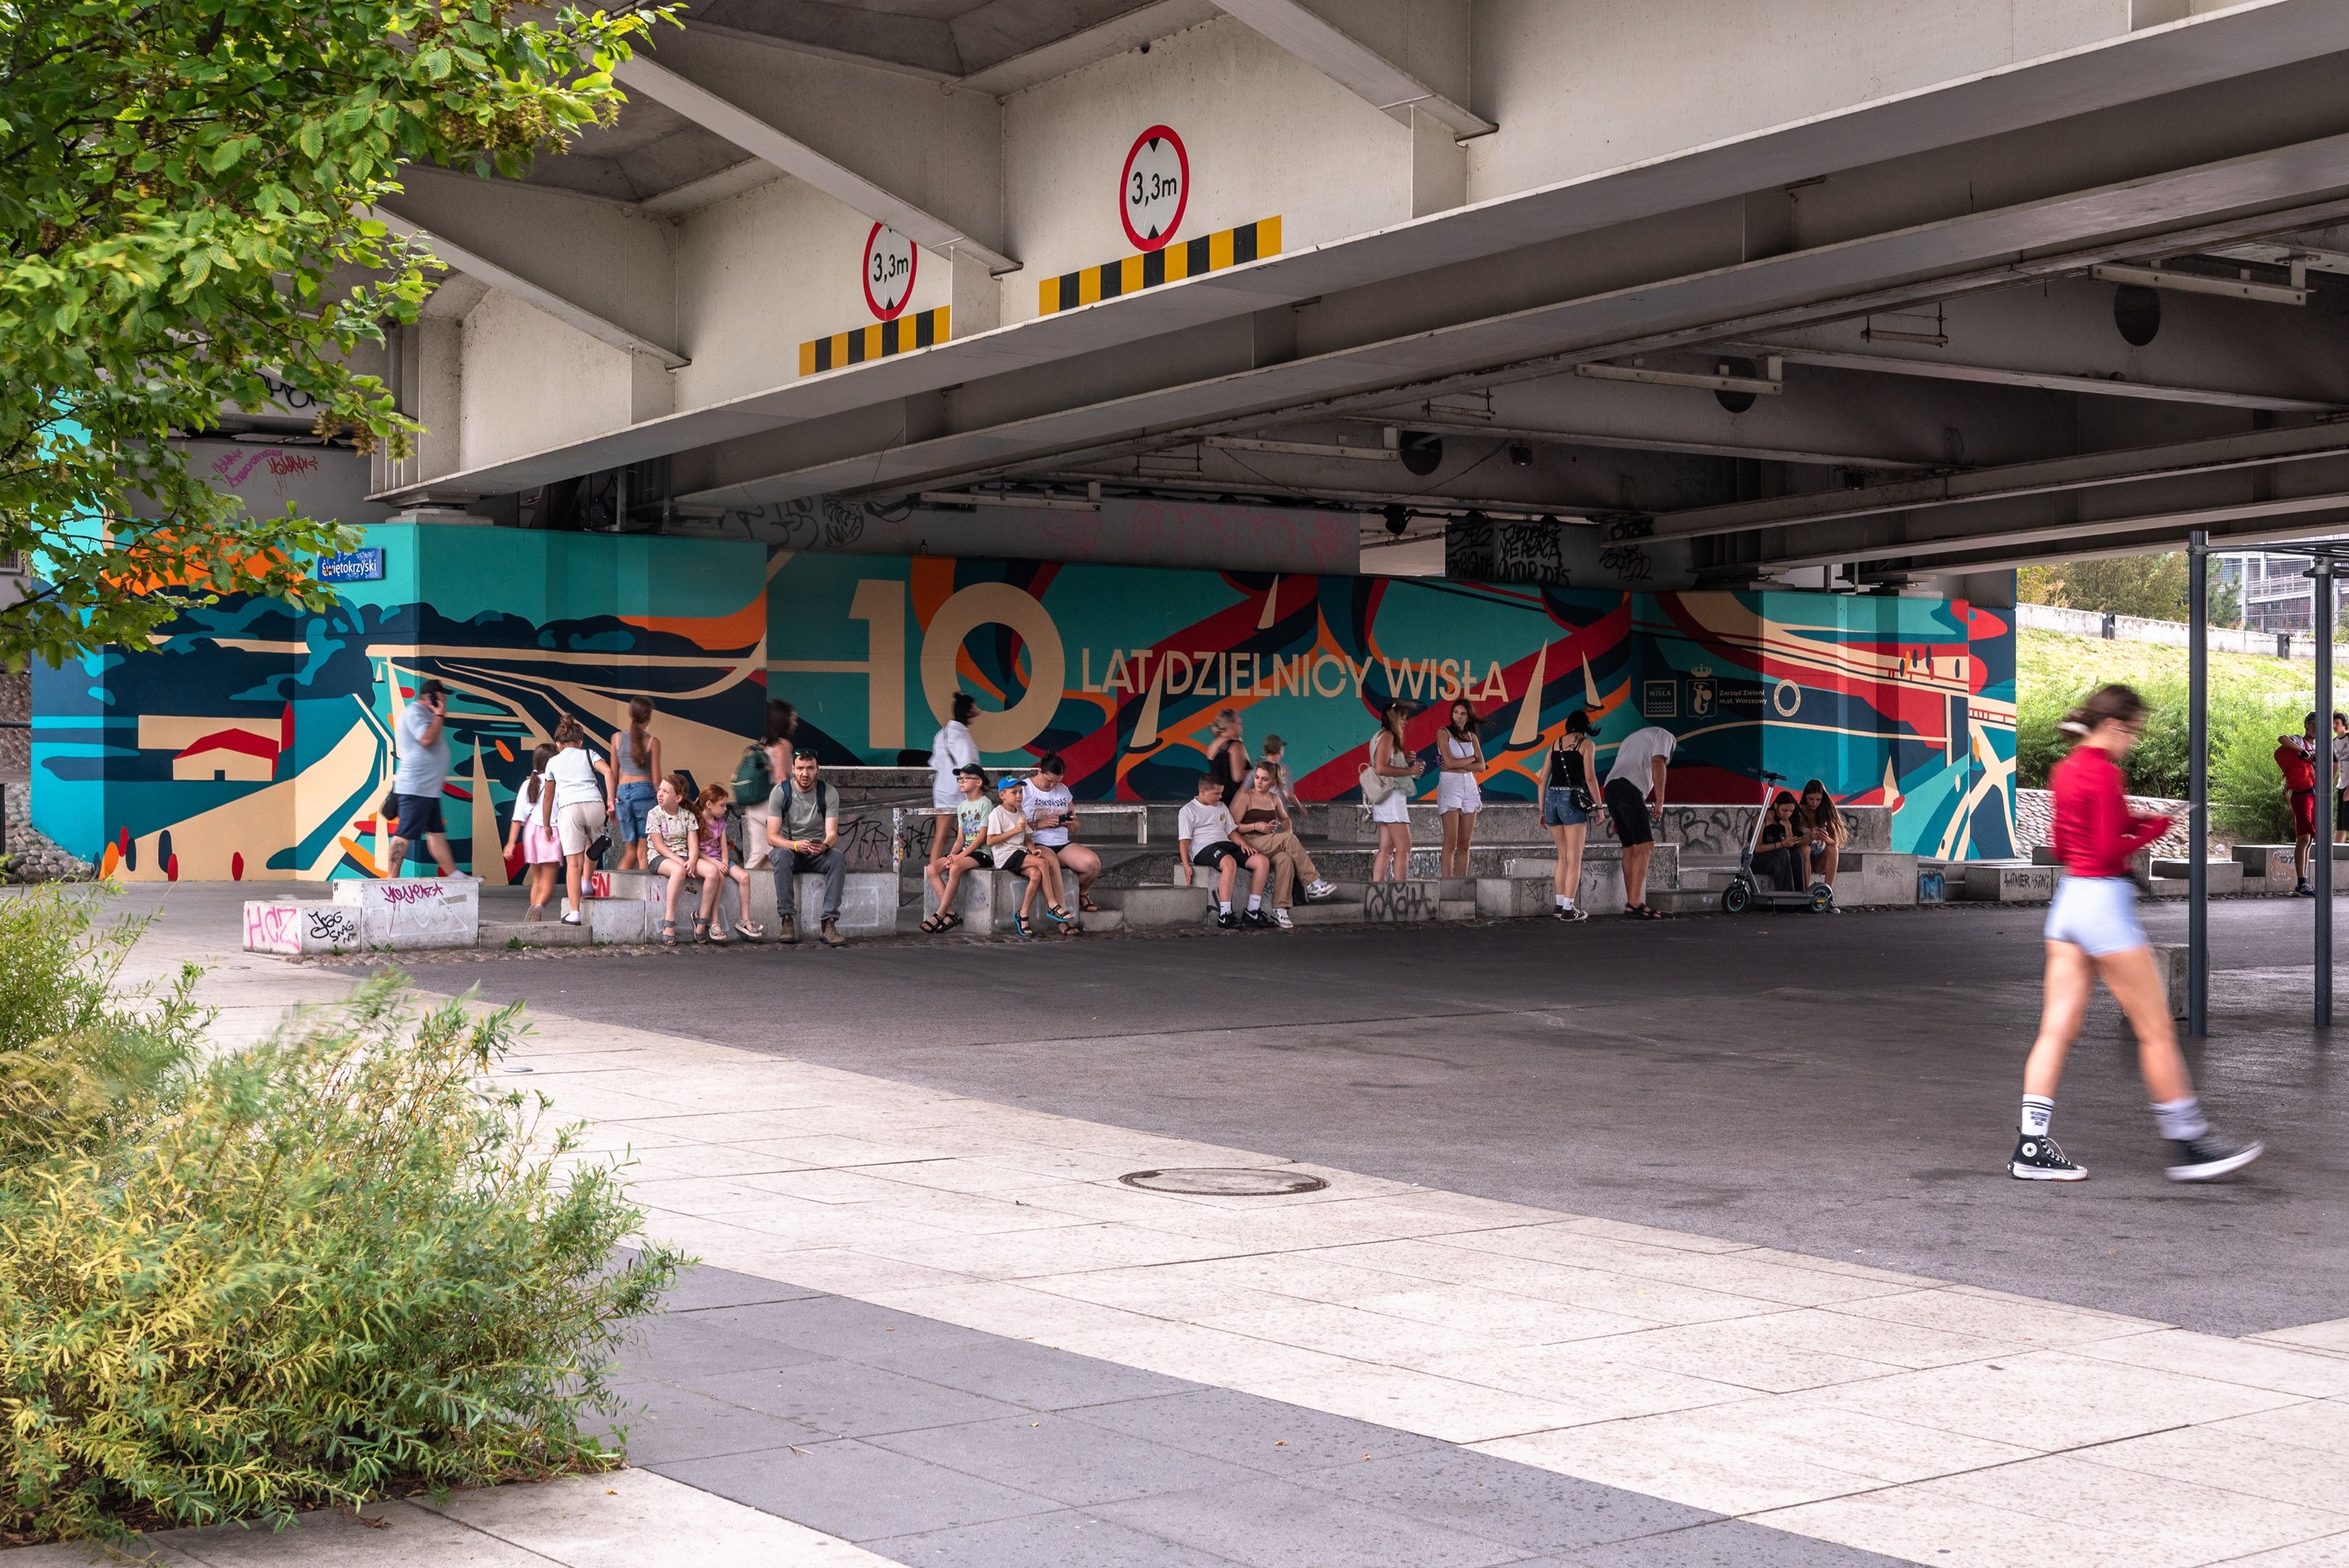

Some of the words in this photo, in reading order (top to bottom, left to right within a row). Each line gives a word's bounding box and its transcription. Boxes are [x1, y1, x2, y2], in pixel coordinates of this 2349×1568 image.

[1130, 171, 1177, 207] 3,3m
[873, 252, 910, 285] 3,3m
[322, 560, 377, 576] Świętokrzyski
[848, 579, 1065, 754] 10
[1082, 648, 1153, 694] LAT
[1167, 650, 1373, 699] DZIELNICY
[1383, 656, 1508, 703] WISŁA
